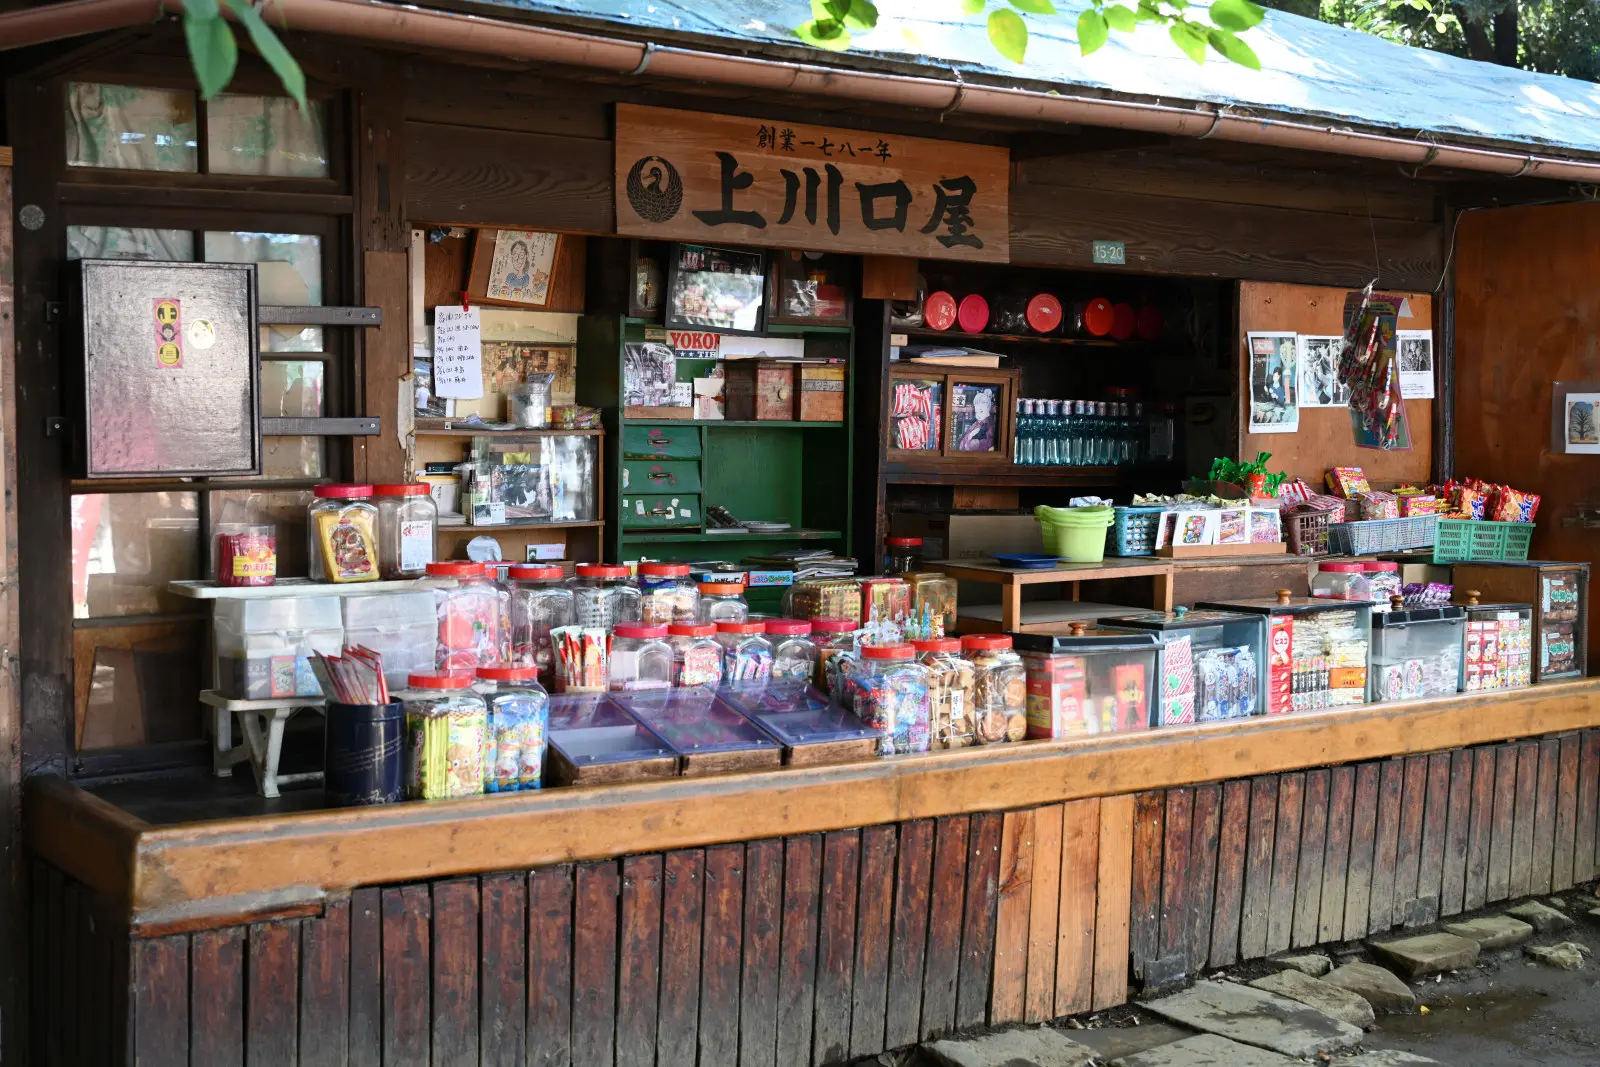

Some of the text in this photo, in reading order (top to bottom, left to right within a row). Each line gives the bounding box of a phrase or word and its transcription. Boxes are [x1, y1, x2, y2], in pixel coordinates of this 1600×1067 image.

[755, 124, 893, 164] 創業一七八一年
[691, 151, 985, 250] 上川口屋
[1095, 245, 1124, 259] 15-20
